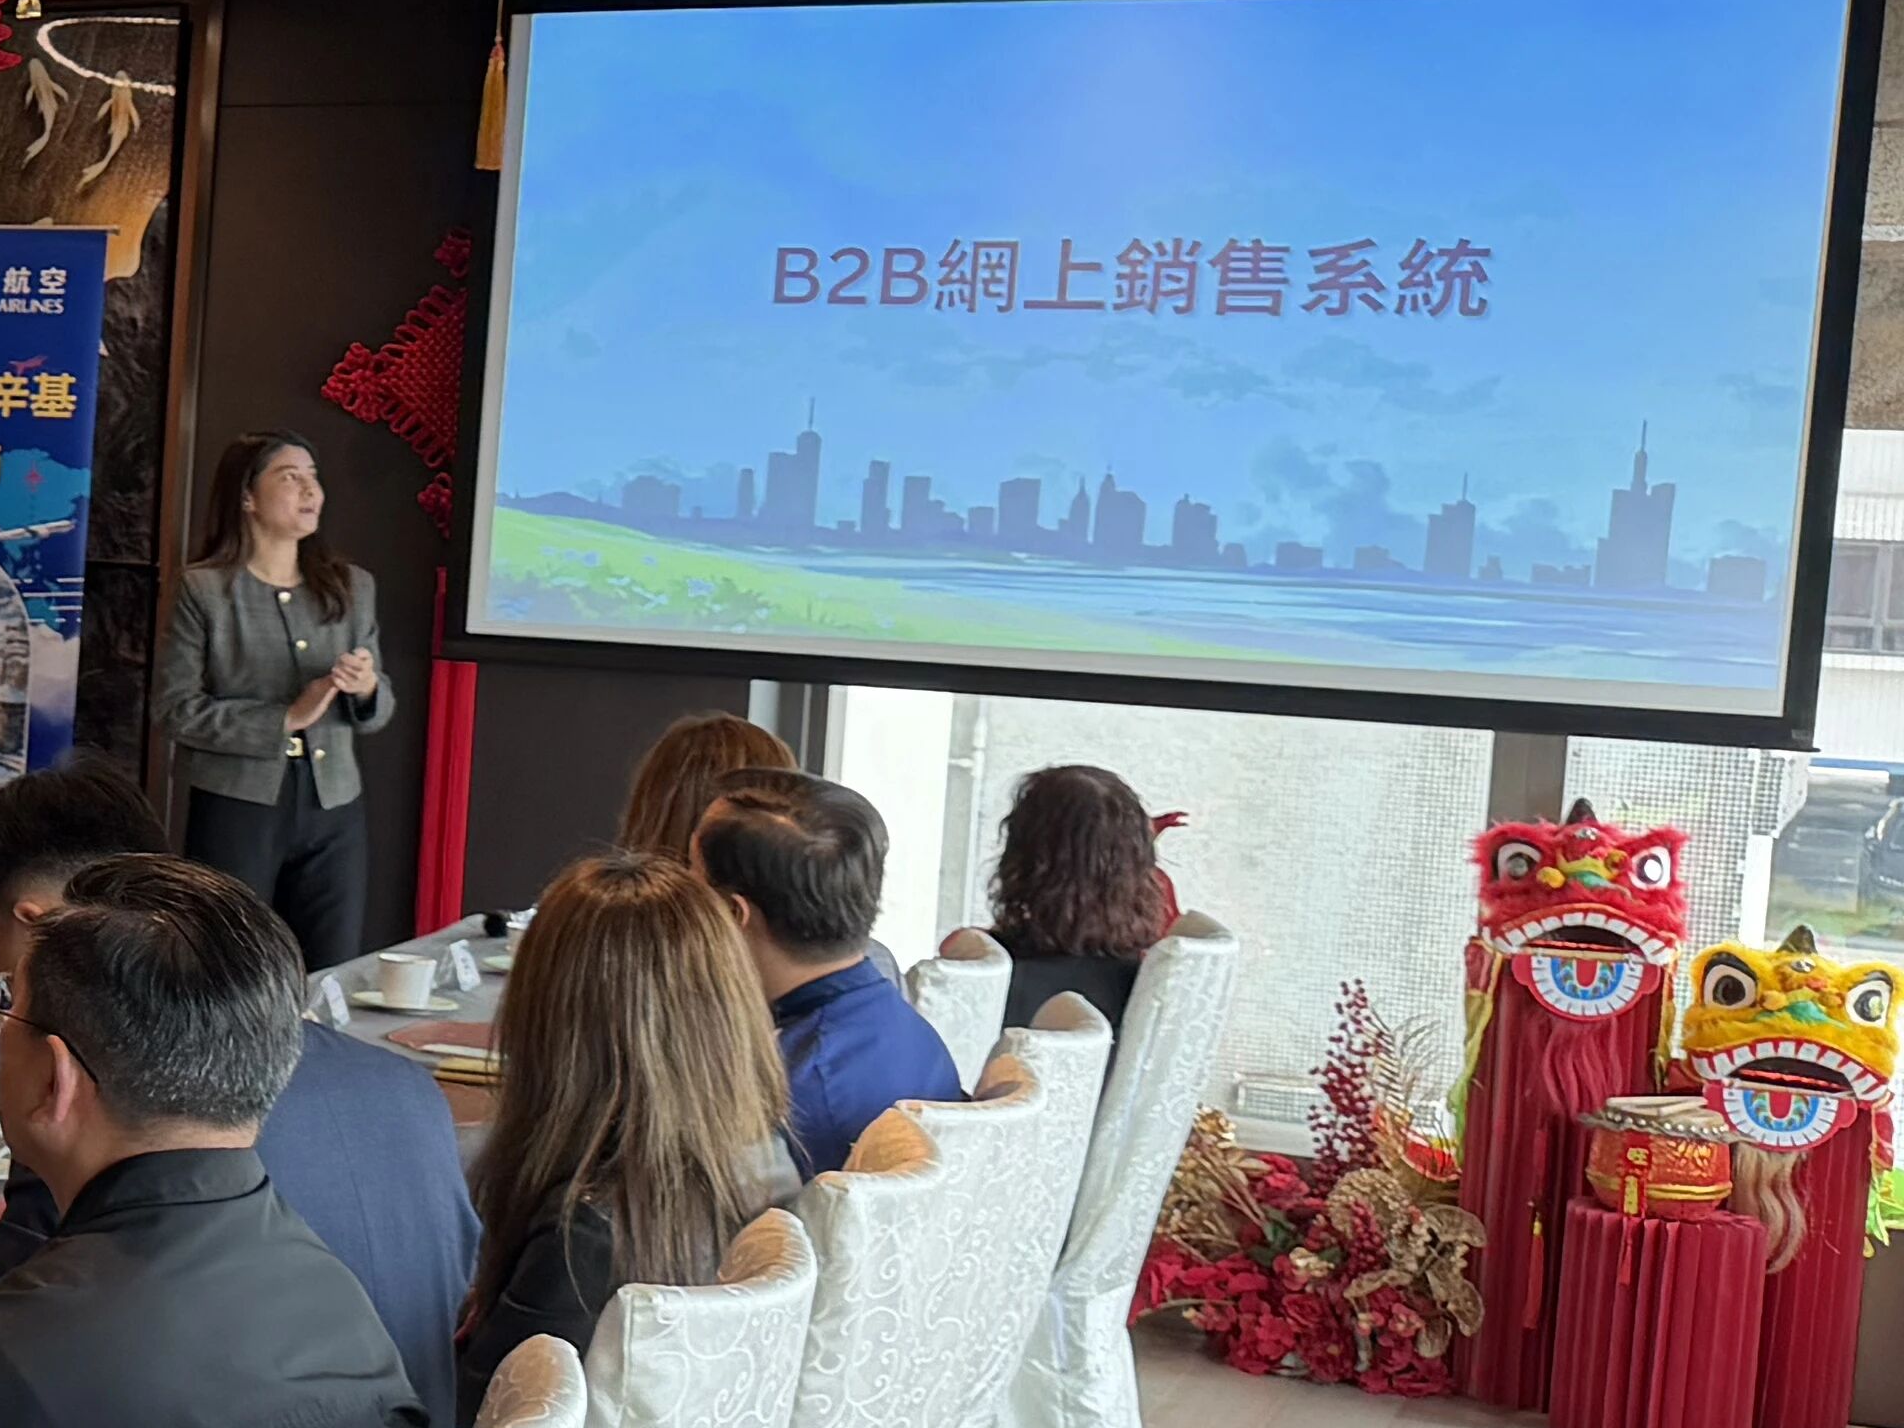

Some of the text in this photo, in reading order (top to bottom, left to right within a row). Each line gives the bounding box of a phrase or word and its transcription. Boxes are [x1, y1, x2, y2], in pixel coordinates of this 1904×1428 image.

[772, 237, 1492, 318] B2B網上銷售系統
